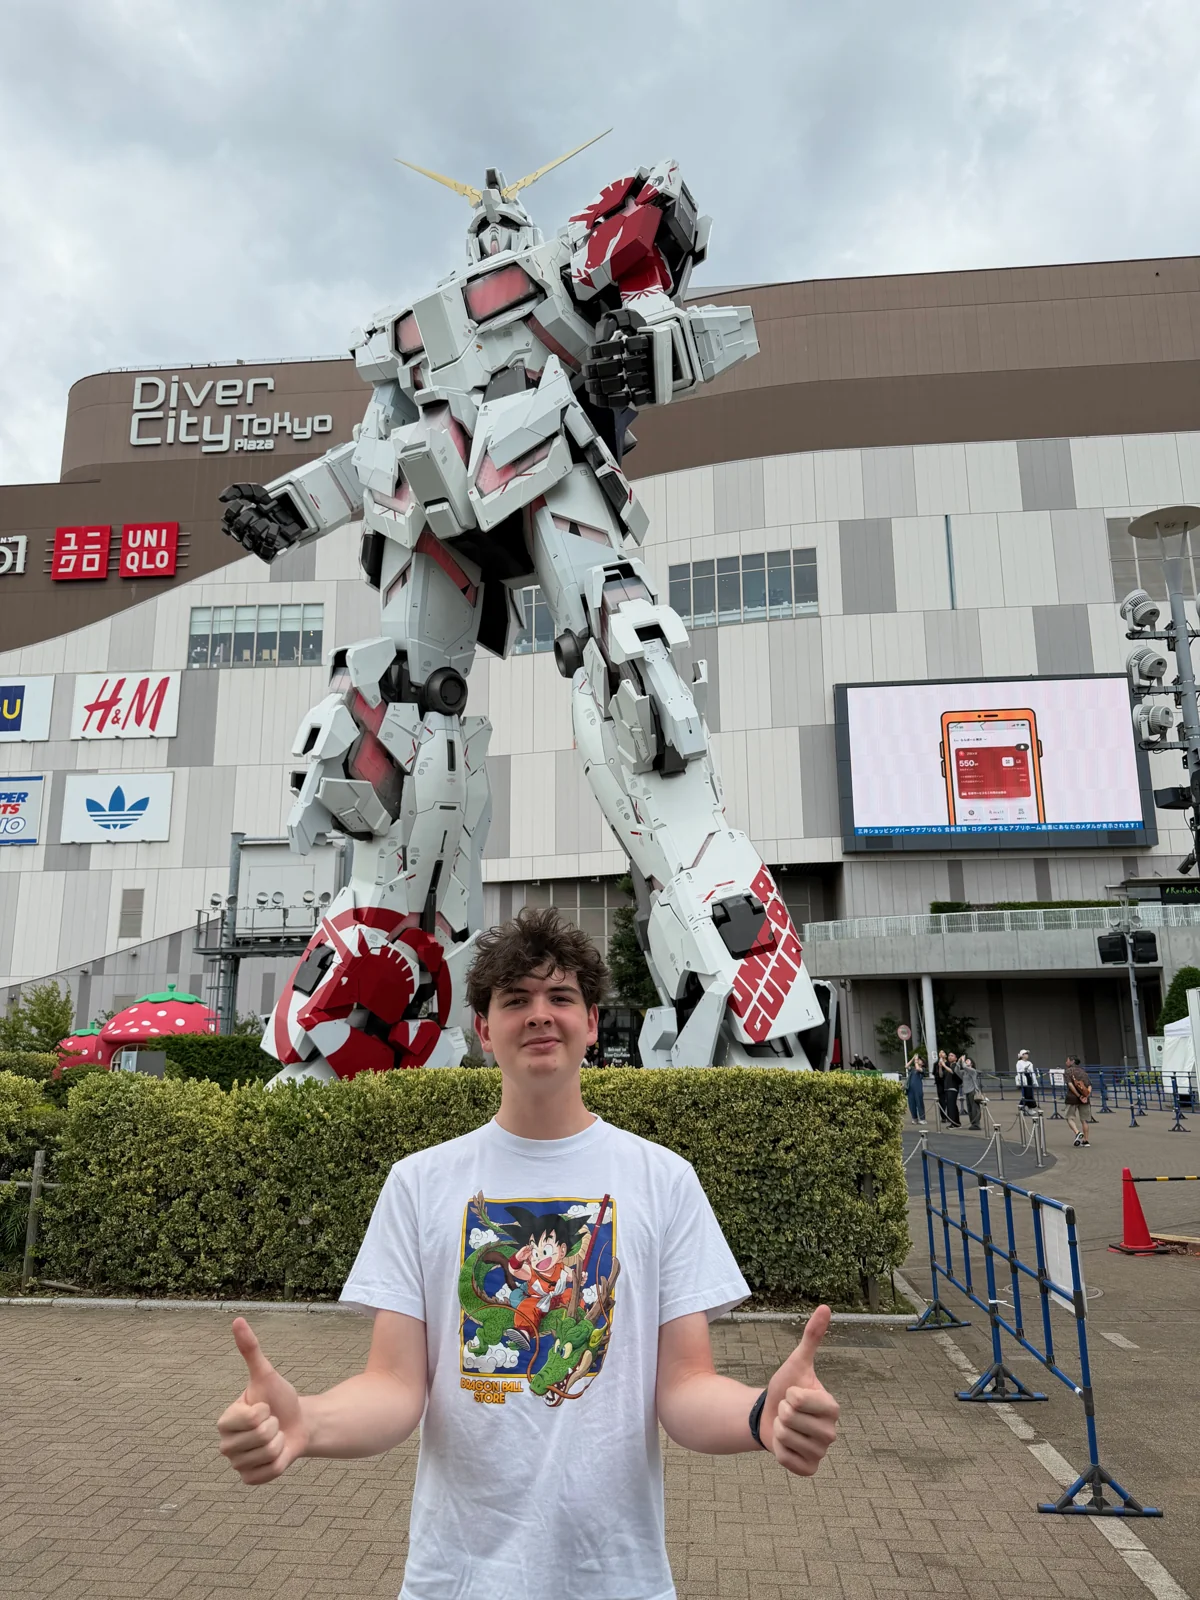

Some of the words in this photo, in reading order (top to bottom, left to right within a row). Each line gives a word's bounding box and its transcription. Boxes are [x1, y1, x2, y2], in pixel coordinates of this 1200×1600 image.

[132, 375, 275, 410] Diver
[130, 409, 232, 454] City
[236, 411, 333, 440] Tokyo
[234, 438, 275, 452] Plaza
[61, 532, 101, 551] ユニ
[127, 529, 167, 548] UNI
[57, 554, 100, 573] クロ
[125, 550, 169, 573] QLO
[82, 676, 171, 734] H&M
[0, 803, 21, 815] TS
[460, 1377, 500, 1391] DRAGON
[501, 1381, 523, 1392] BALL
[474, 1391, 505, 1403] STORE
